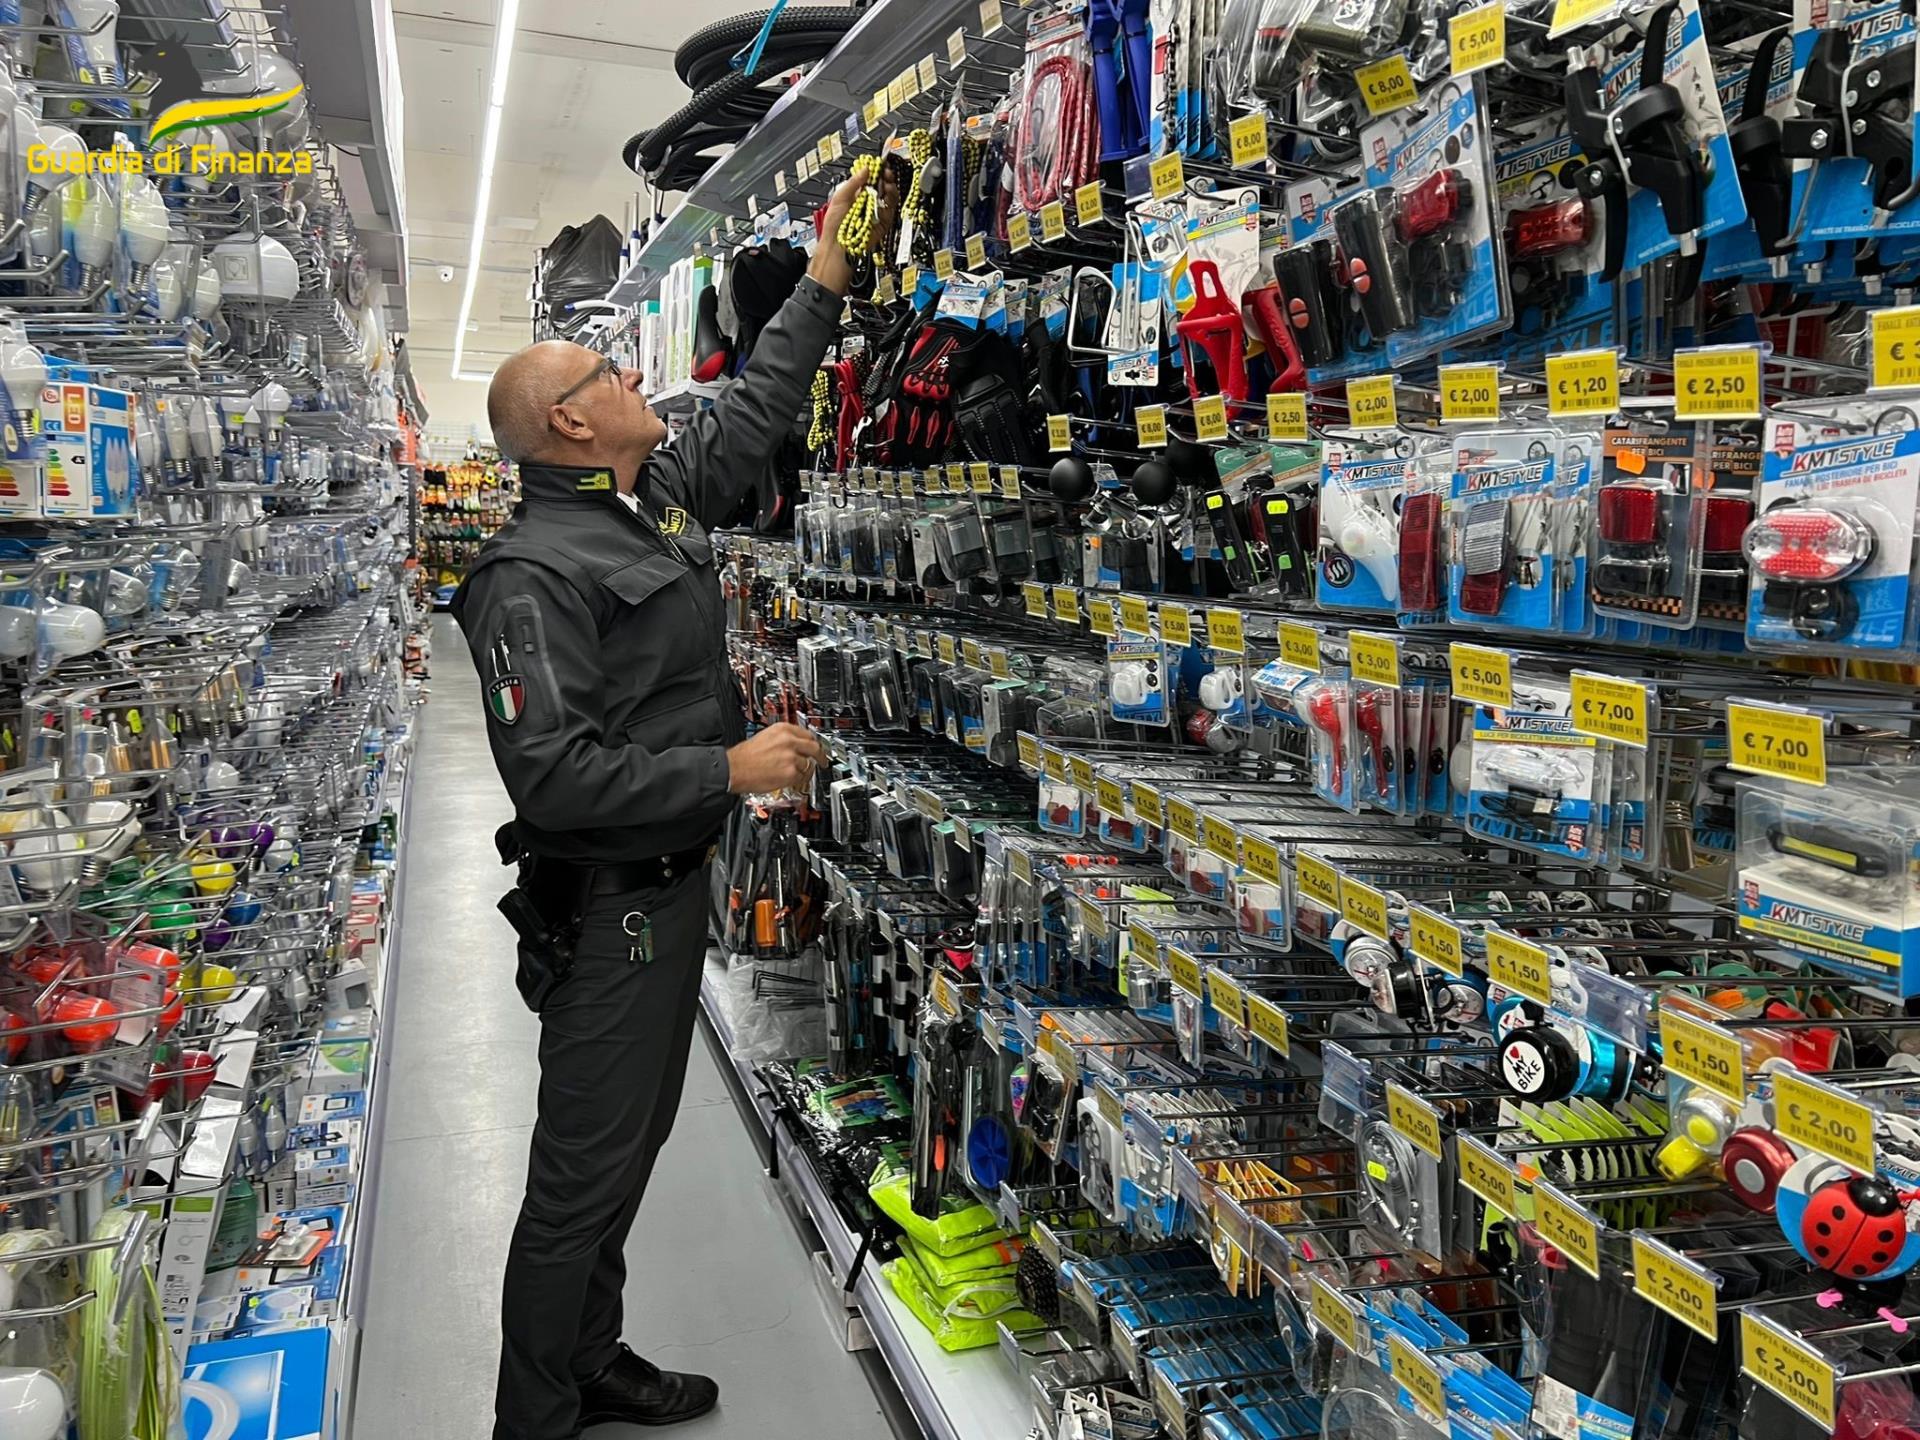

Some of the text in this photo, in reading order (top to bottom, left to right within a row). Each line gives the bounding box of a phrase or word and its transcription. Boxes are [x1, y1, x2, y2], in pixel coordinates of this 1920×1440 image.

[1458, 27, 1496, 50] € 5,00
[1368, 75, 1404, 96] € 8,00
[1236, 132, 1261, 149] € 8,00
[1156, 176, 1162, 186] €
[1890, 342, 1905, 361] €
[1450, 388, 1490, 404] € 2,00
[1558, 377, 1607, 396] € 1,20
[1687, 376, 1745, 397] € 2,50
[68, 394, 82, 424] LED
[1356, 396, 1388, 412] € 2,00
[1274, 411, 1301, 424] € 2,50
[1611, 437, 1687, 446] CATARIFRANGENTE
[1733, 461, 1753, 470] BICI
[1794, 441, 1896, 472] KMTSTYLE
[1344, 464, 1406, 482] KMTSTYLE
[1468, 464, 1543, 491] KMTSTYLE
[1164, 620, 1186, 633] € 5,00
[1213, 623, 1238, 637] € 3,00
[1286, 641, 1313, 657] € 3,00
[1357, 652, 1391, 670] € 3,00
[492, 679, 519, 693] ITALIA
[1460, 667, 1502, 686] € 5,00
[1582, 699, 1634, 721] € 7,00
[1743, 732, 1808, 757] € 7,00
[1216, 834, 1232, 850] 1,50
[1248, 850, 1274, 871] € 1,50
[1303, 870, 1332, 894] € 2,00
[1347, 897, 1354, 909] €
[1356, 901, 1380, 922] 2,00
[1772, 903, 1865, 941] KMTSTYLE
[1418, 928, 1453, 956] € 1,50
[1496, 954, 1539, 982] € 1,50
[1512, 1055, 1528, 1078] MY
[1673, 1040, 1729, 1076] € 1,50
[1518, 1060, 1541, 1090] BIKE
[1396, 1106, 1431, 1138] € 1,50
[1788, 1103, 1857, 1144] € 2,00
[1468, 1161, 1506, 1196] € 2,00
[1543, 1210, 1553, 1225] €
[1556, 1218, 1587, 1250] 2,00
[1646, 1267, 1703, 1311] € 2,00
[1318, 1296, 1324, 1310] €
[1397, 1357, 1434, 1396] € 1,00
[1755, 1346, 1820, 1397] € 2,00
